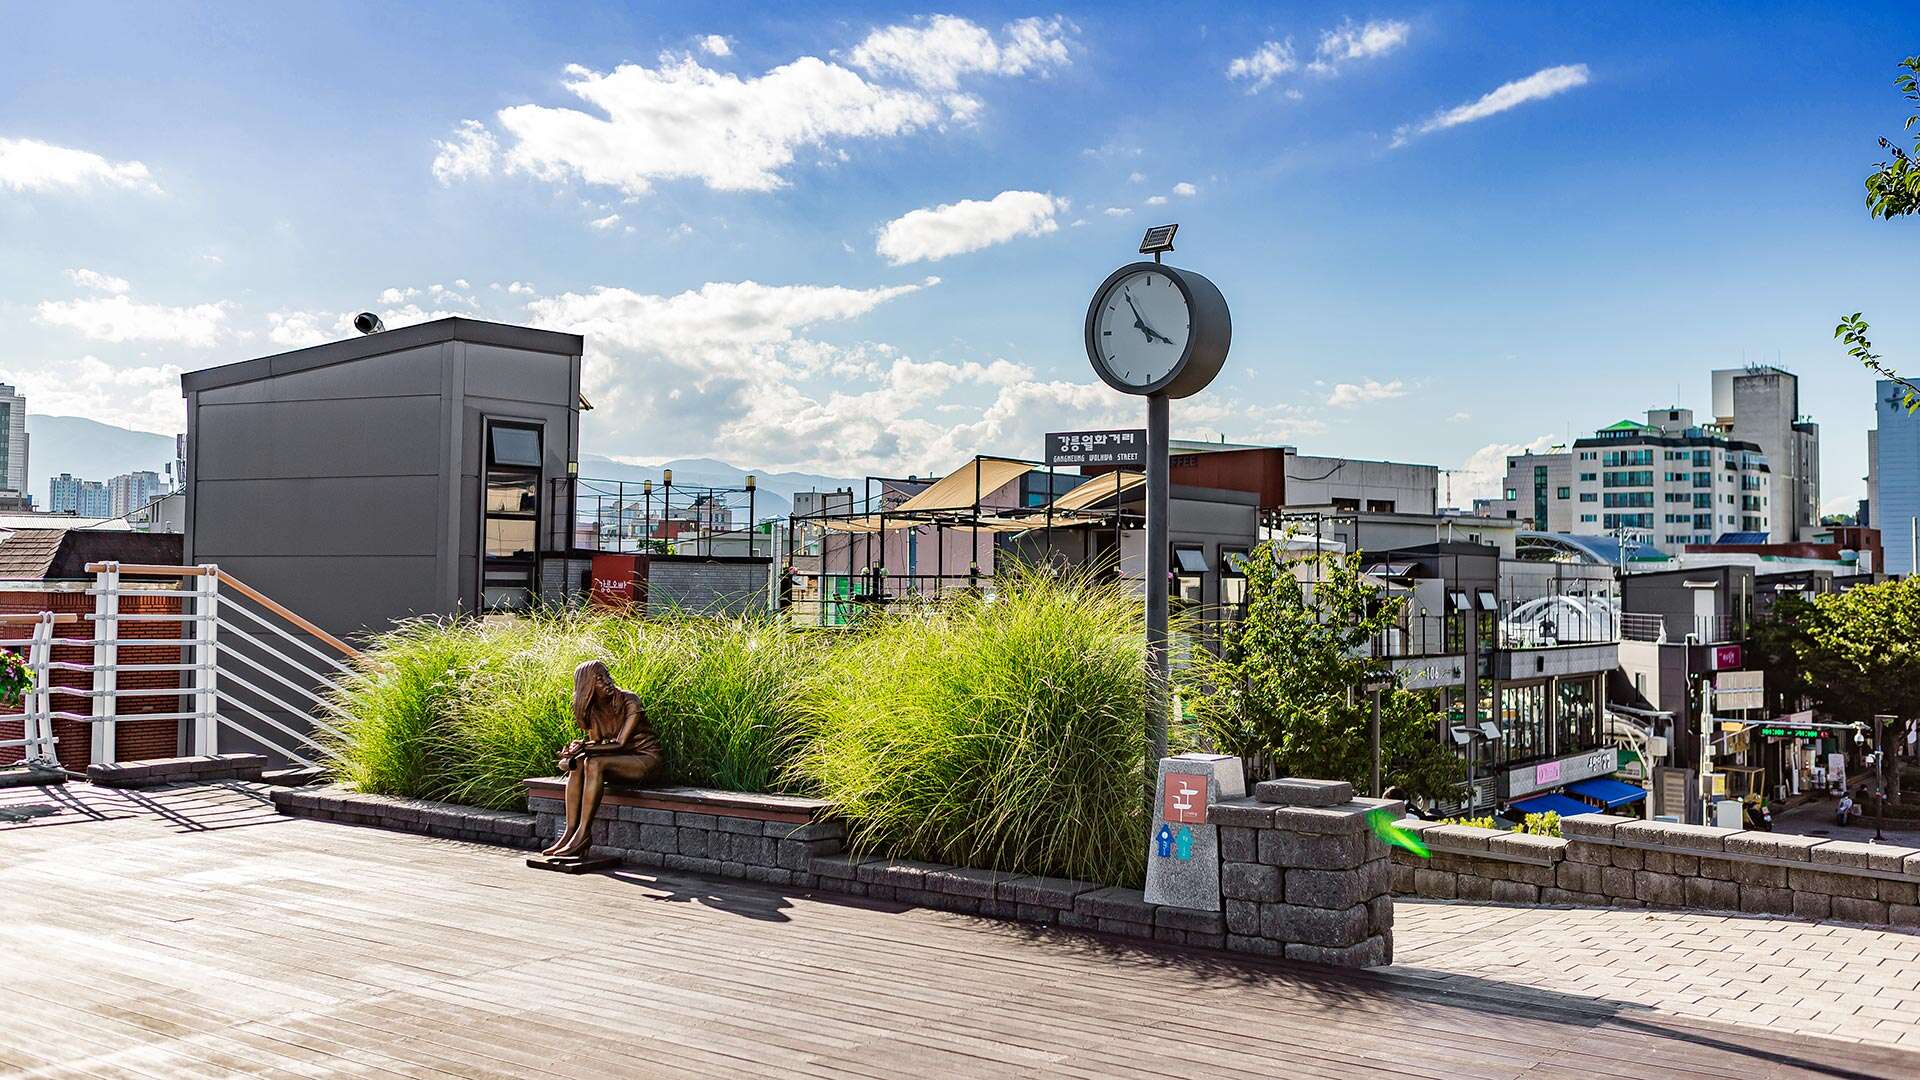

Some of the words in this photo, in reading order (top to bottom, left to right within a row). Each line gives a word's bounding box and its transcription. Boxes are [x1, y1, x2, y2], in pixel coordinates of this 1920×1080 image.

[1053, 454, 1085, 463] GANGNEUNG
[1089, 453, 1113, 462] WOLHWA
[1117, 452, 1138, 461] STREET
